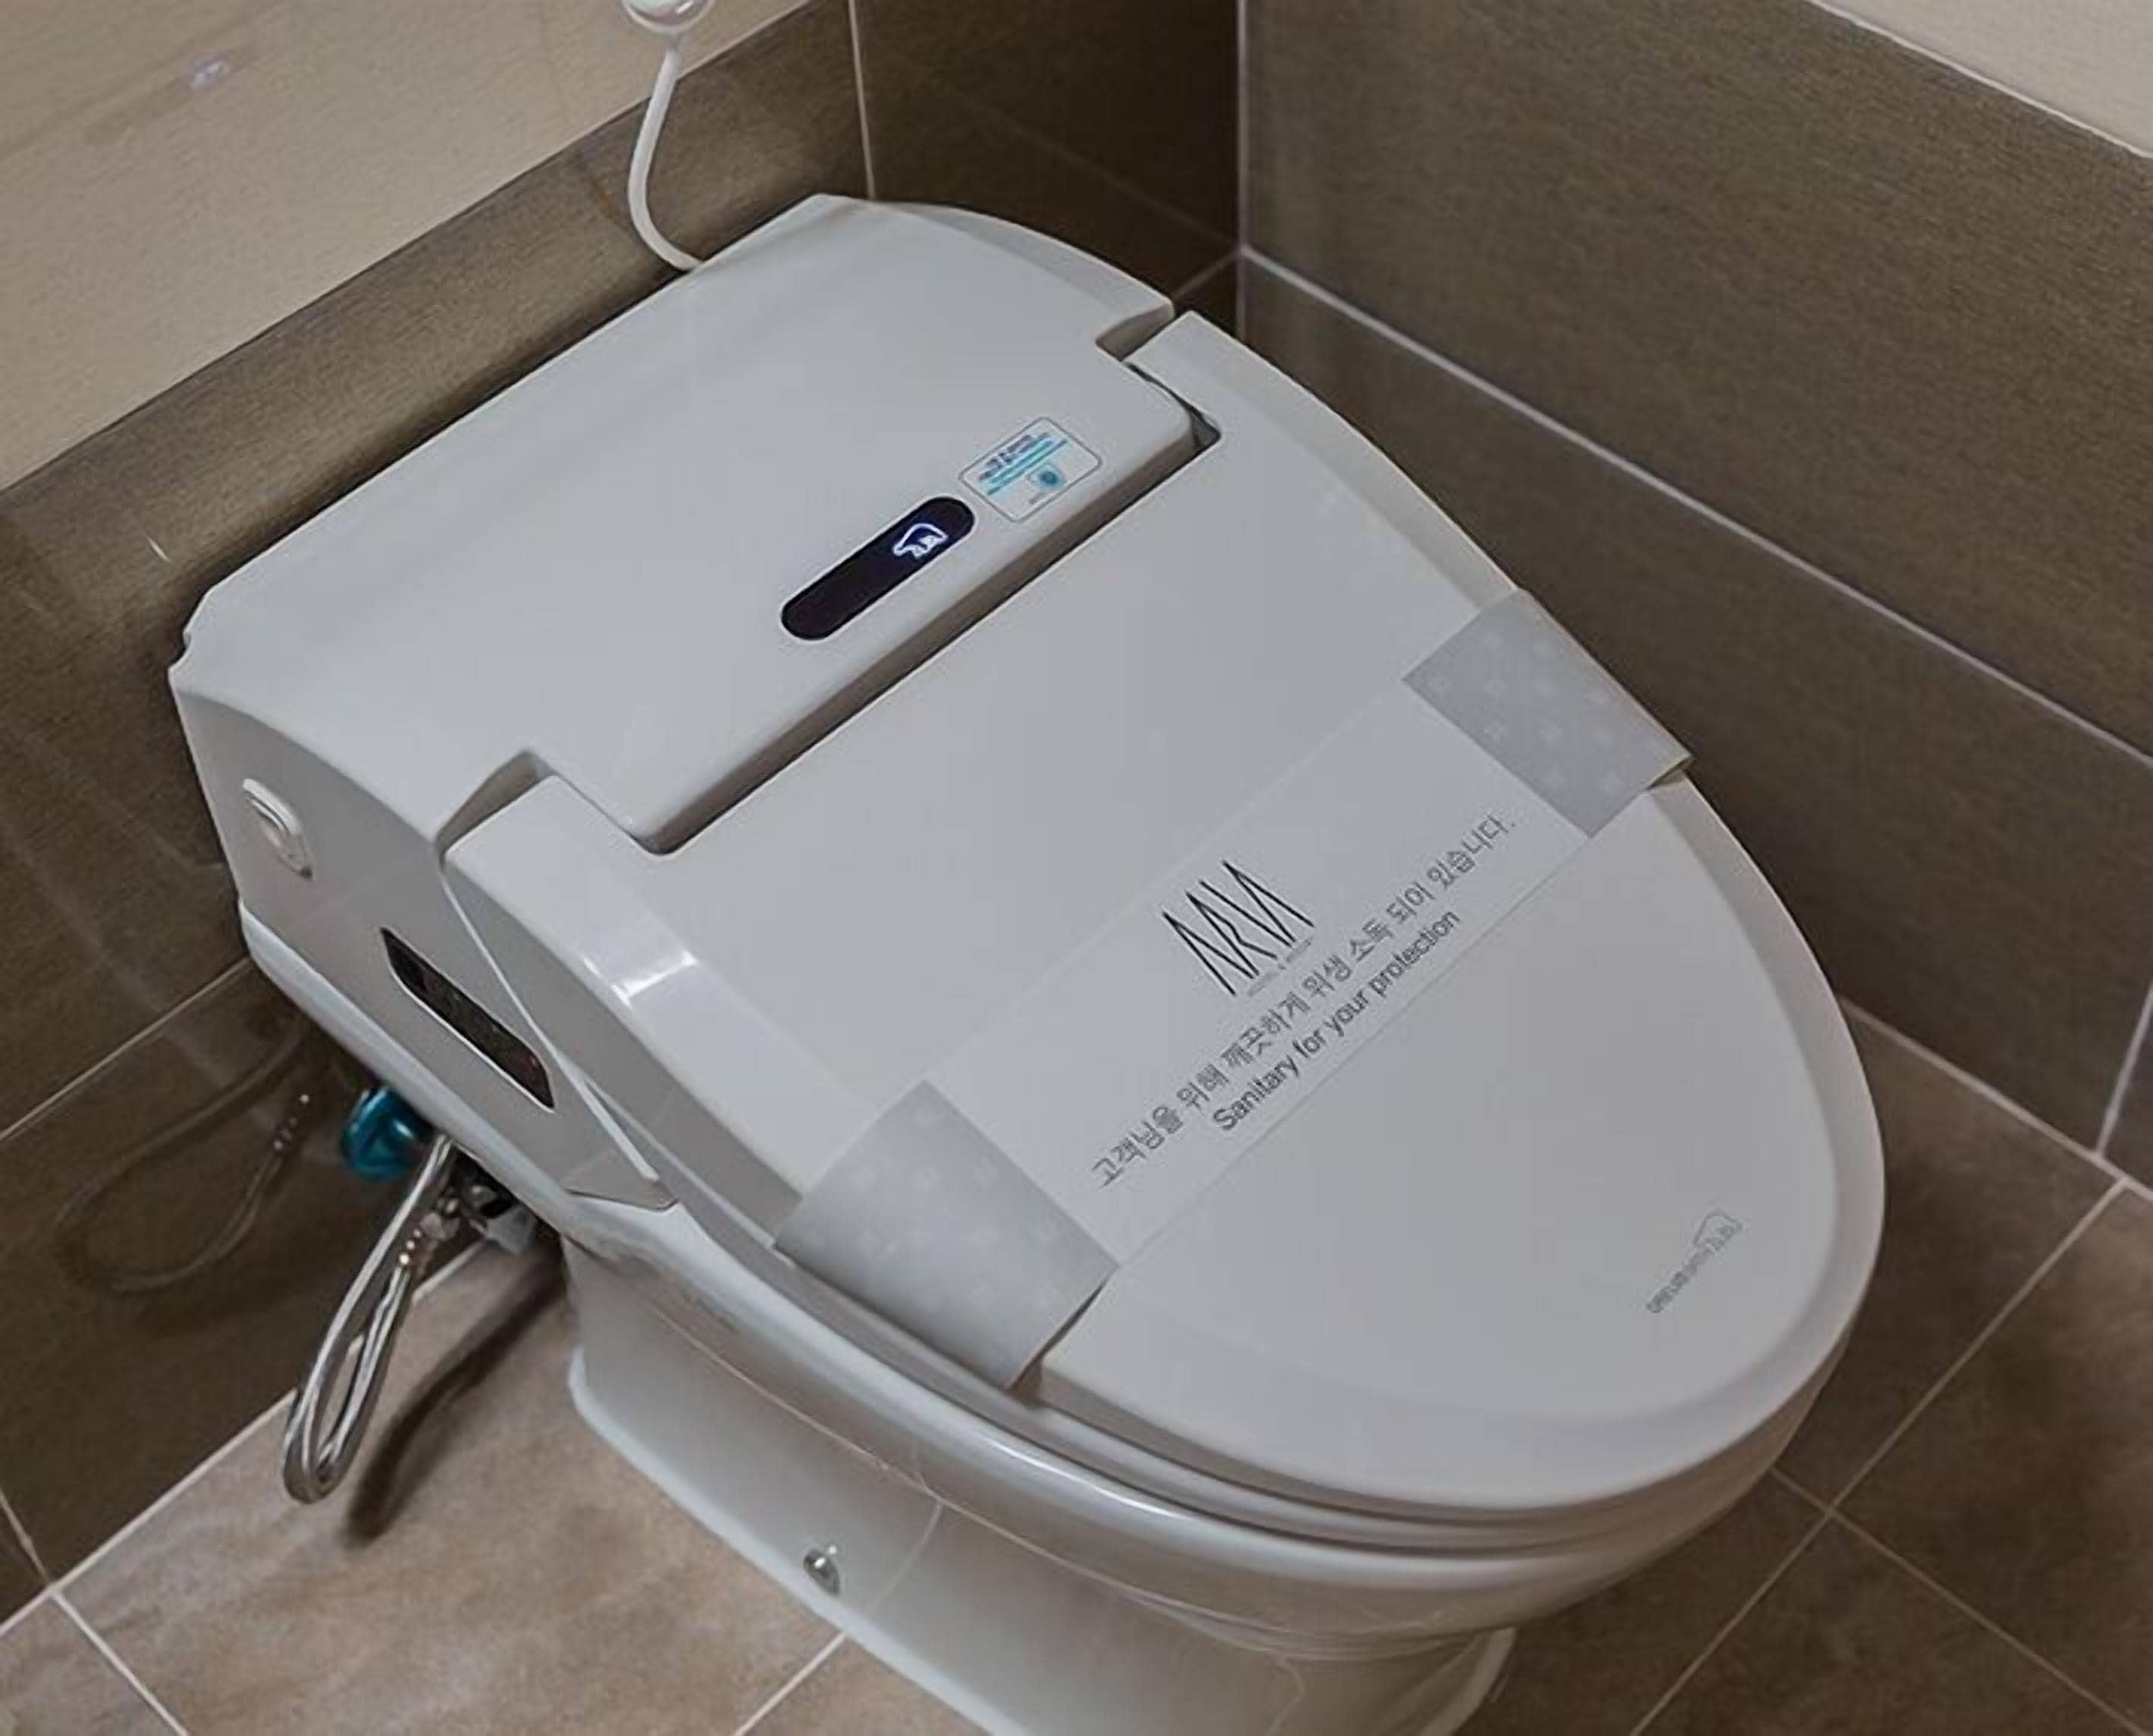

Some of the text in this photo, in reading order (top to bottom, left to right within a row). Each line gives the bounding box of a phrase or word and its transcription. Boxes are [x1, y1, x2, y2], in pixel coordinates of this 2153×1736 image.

[1092, 1106, 1183, 1187] 고객님을
[1176, 1064, 1229, 1110] 위해
[1302, 955, 1352, 997] 위생
[1349, 920, 1394, 962] 소독
[1213, 1055, 1299, 1130] Sanitary
[1292, 1028, 1327, 1059] for
[1323, 990, 1370, 1037] your
[1368, 911, 1460, 999] protection
